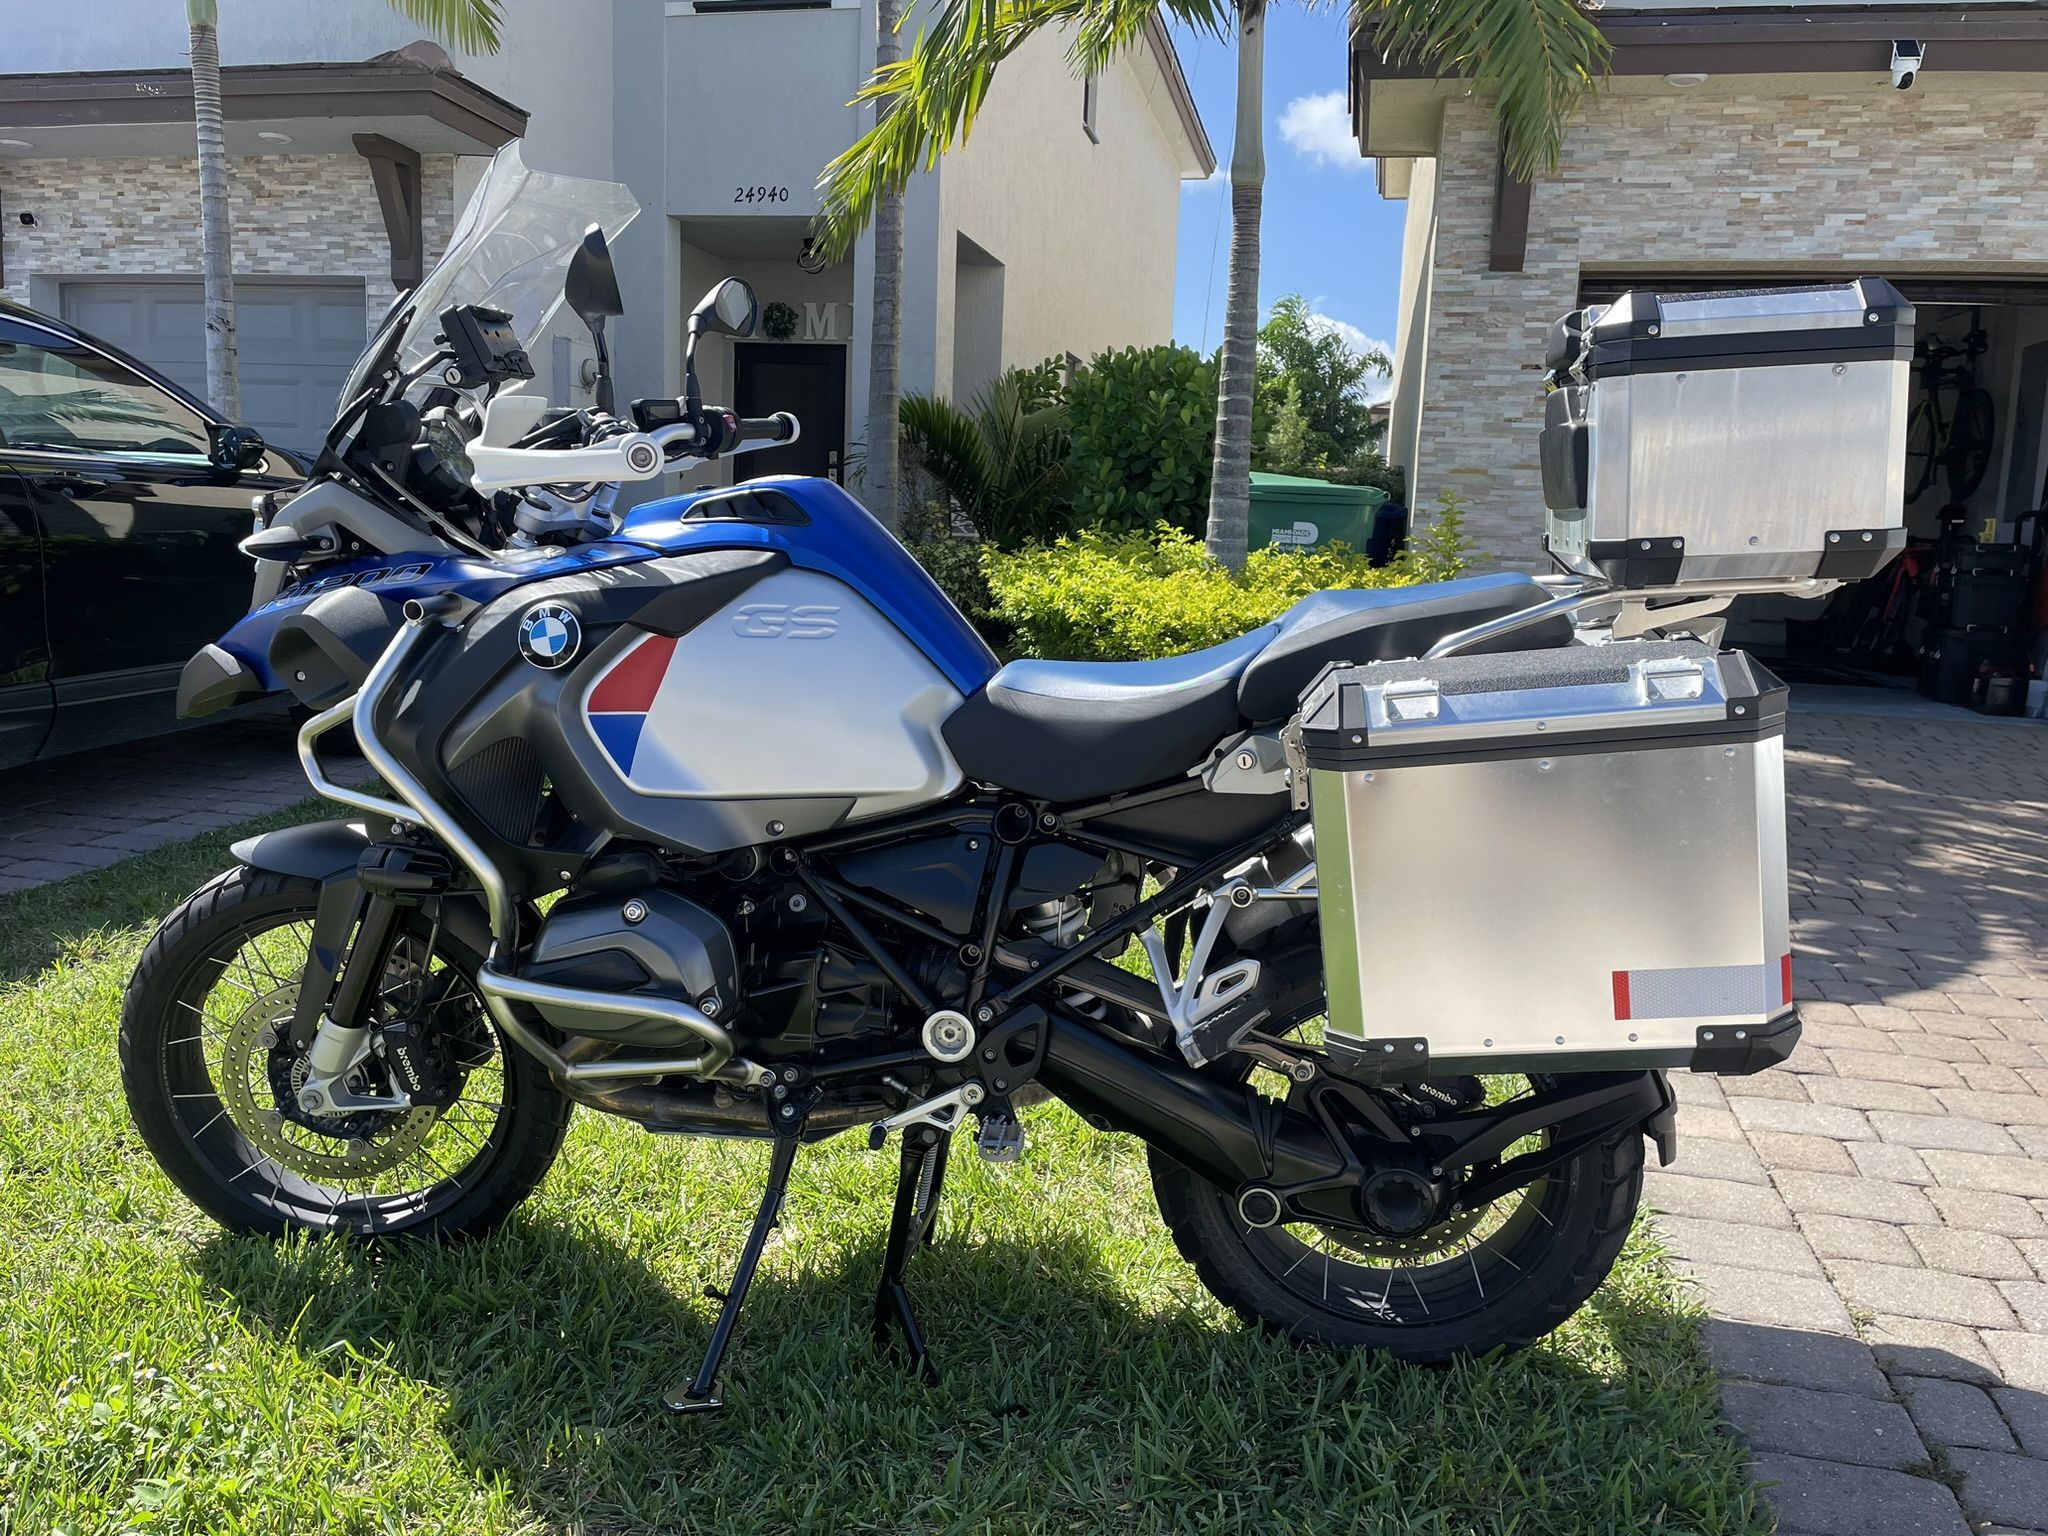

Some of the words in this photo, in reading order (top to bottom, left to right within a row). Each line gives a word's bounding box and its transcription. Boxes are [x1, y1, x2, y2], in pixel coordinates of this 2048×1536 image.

[734, 186, 789, 203] 24940
[522, 607, 572, 632] BMW
[731, 603, 841, 640] GS
[396, 1046, 421, 1092] brembo
[1419, 1082, 1458, 1106] brembo
